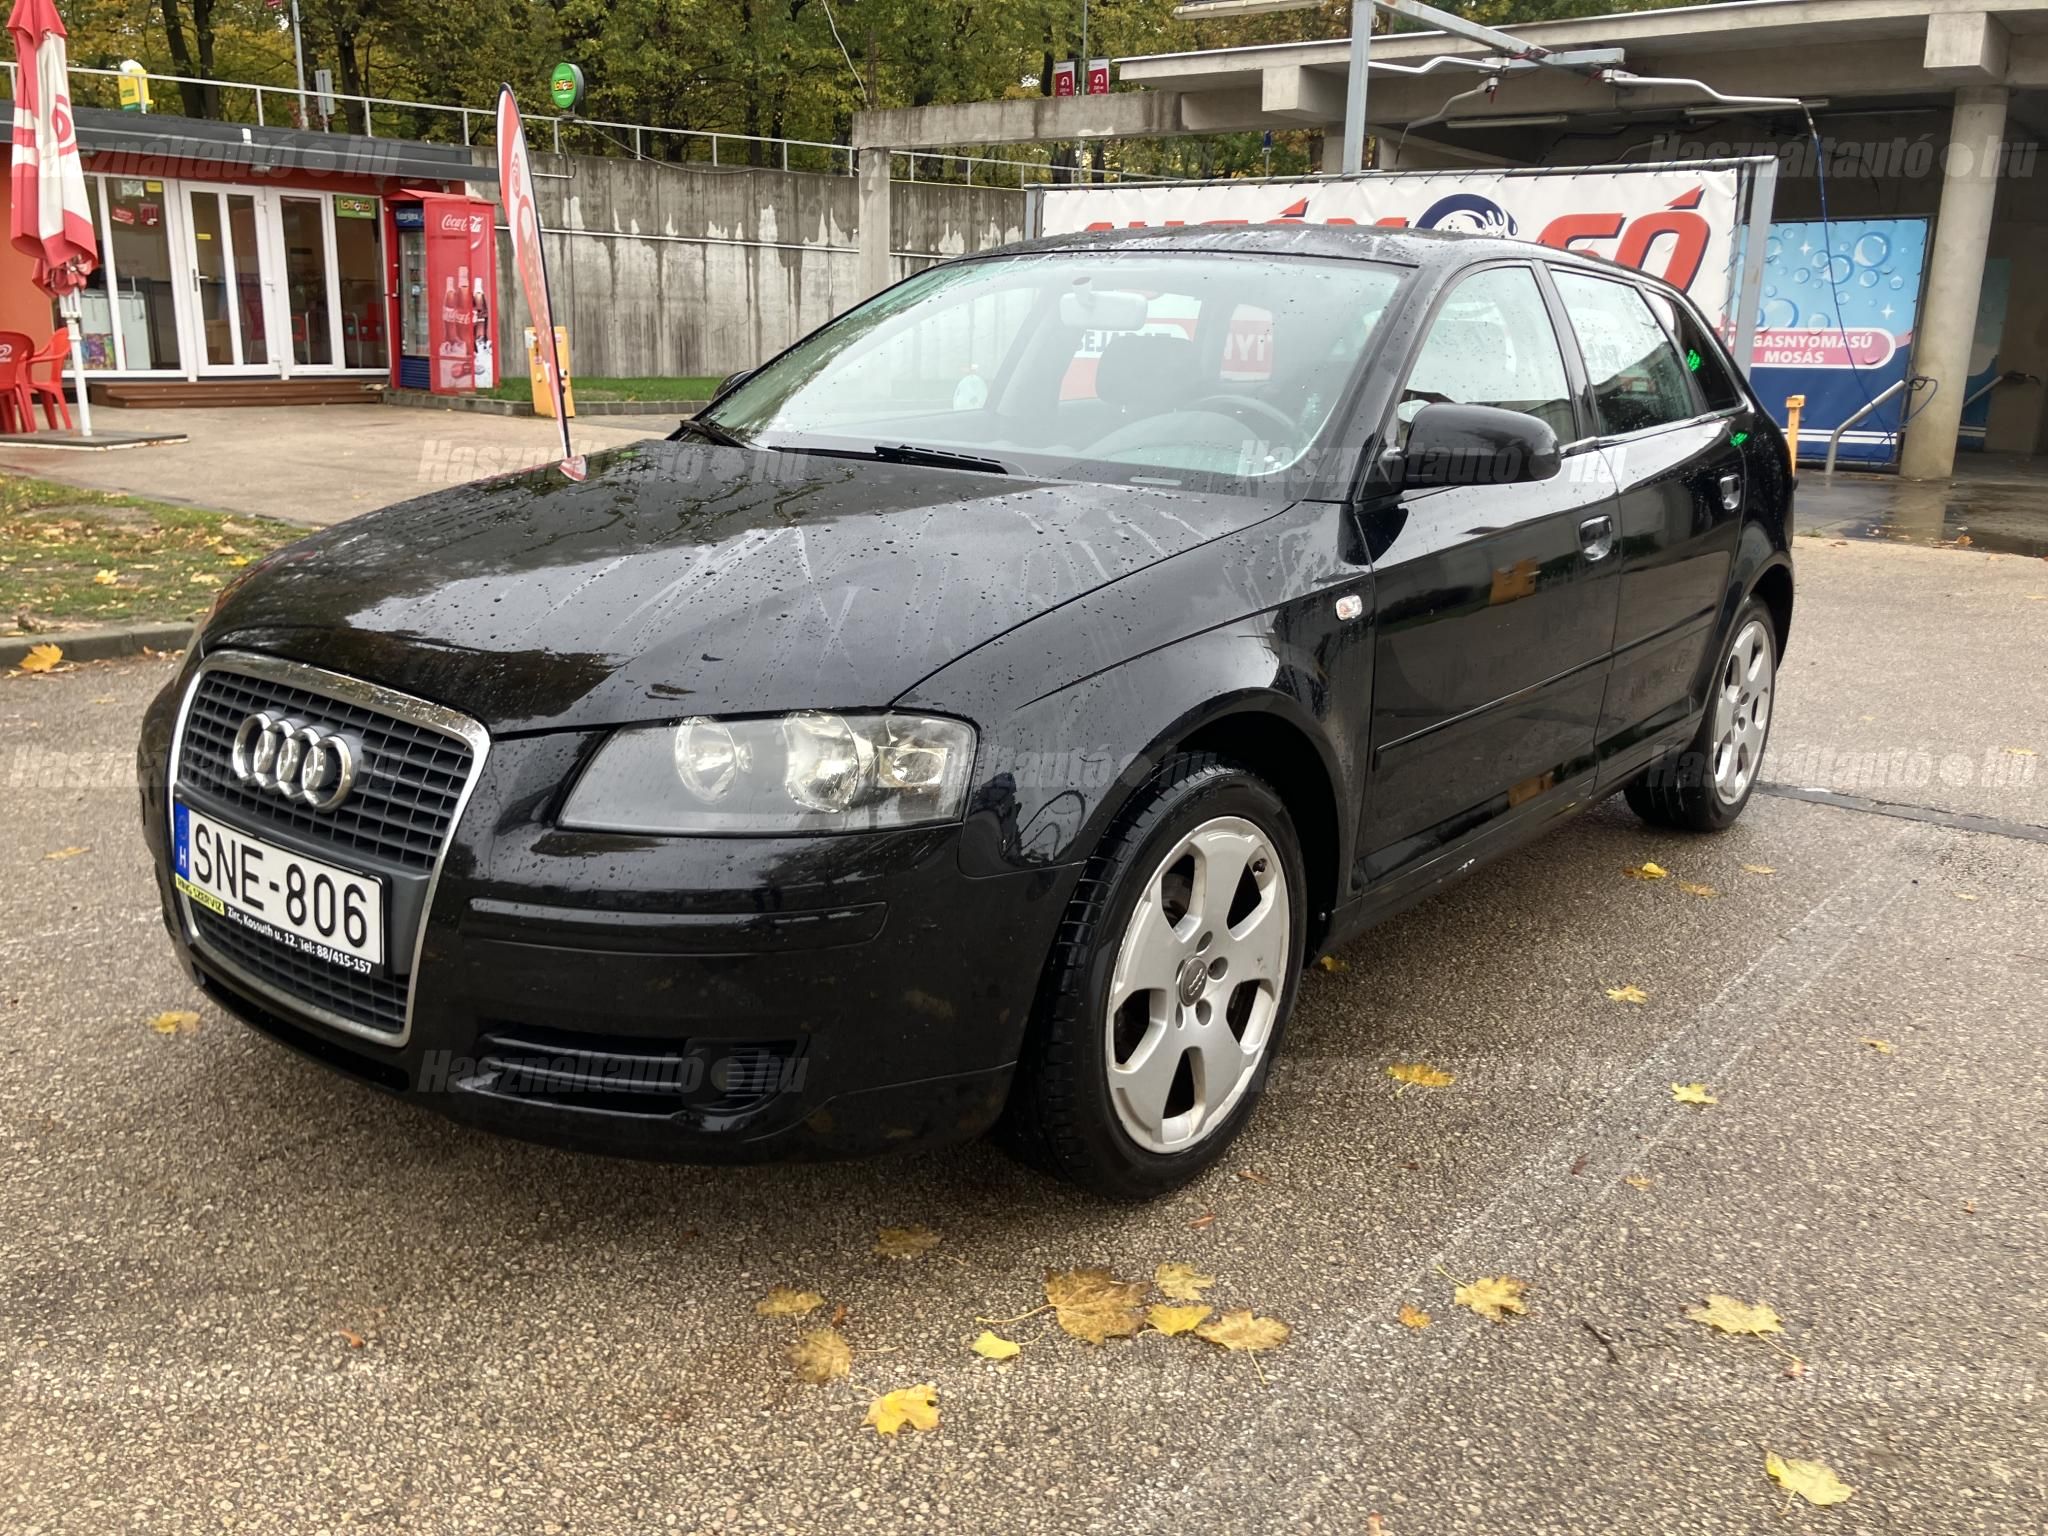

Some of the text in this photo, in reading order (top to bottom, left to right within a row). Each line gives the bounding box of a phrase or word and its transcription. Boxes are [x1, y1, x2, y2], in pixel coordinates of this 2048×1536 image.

[1763, 348, 1825, 364] MOSÁS
[179, 846, 187, 869] H
[194, 823, 368, 948] SNE-806
[243, 914, 274, 938] Kossuth
[274, 930, 283, 942] u.
[284, 932, 298, 948] 12.
[316, 944, 373, 975] 88/415-157
